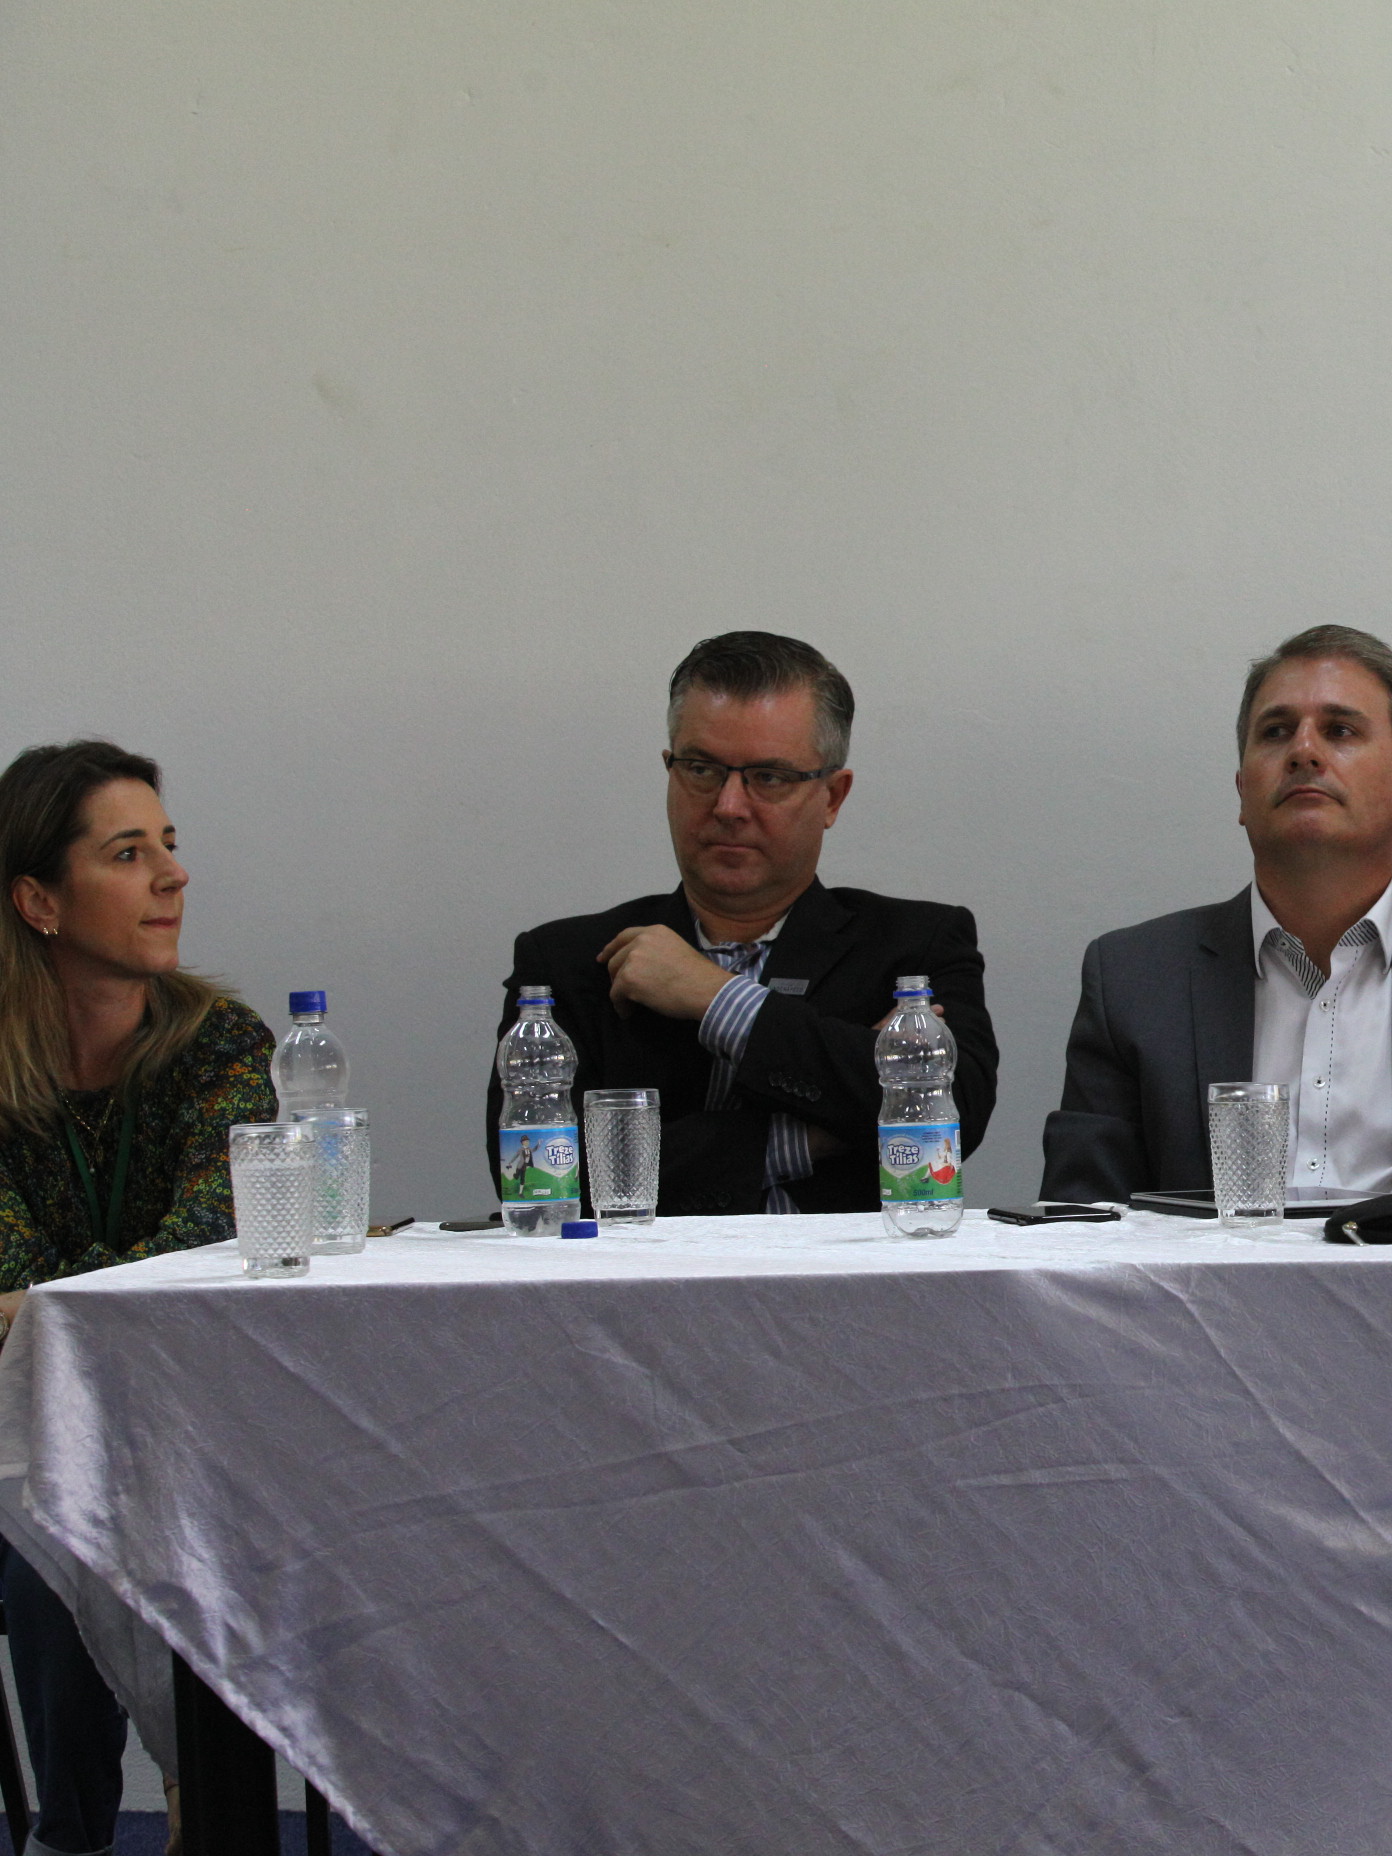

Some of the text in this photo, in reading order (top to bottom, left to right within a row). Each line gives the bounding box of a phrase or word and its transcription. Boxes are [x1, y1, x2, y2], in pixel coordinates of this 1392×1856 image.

[546, 1145, 573, 1156] Treze
[888, 1145, 919, 1155] Treze
[549, 1153, 573, 1165] Tílias
[889, 1152, 919, 1165] Tílias
